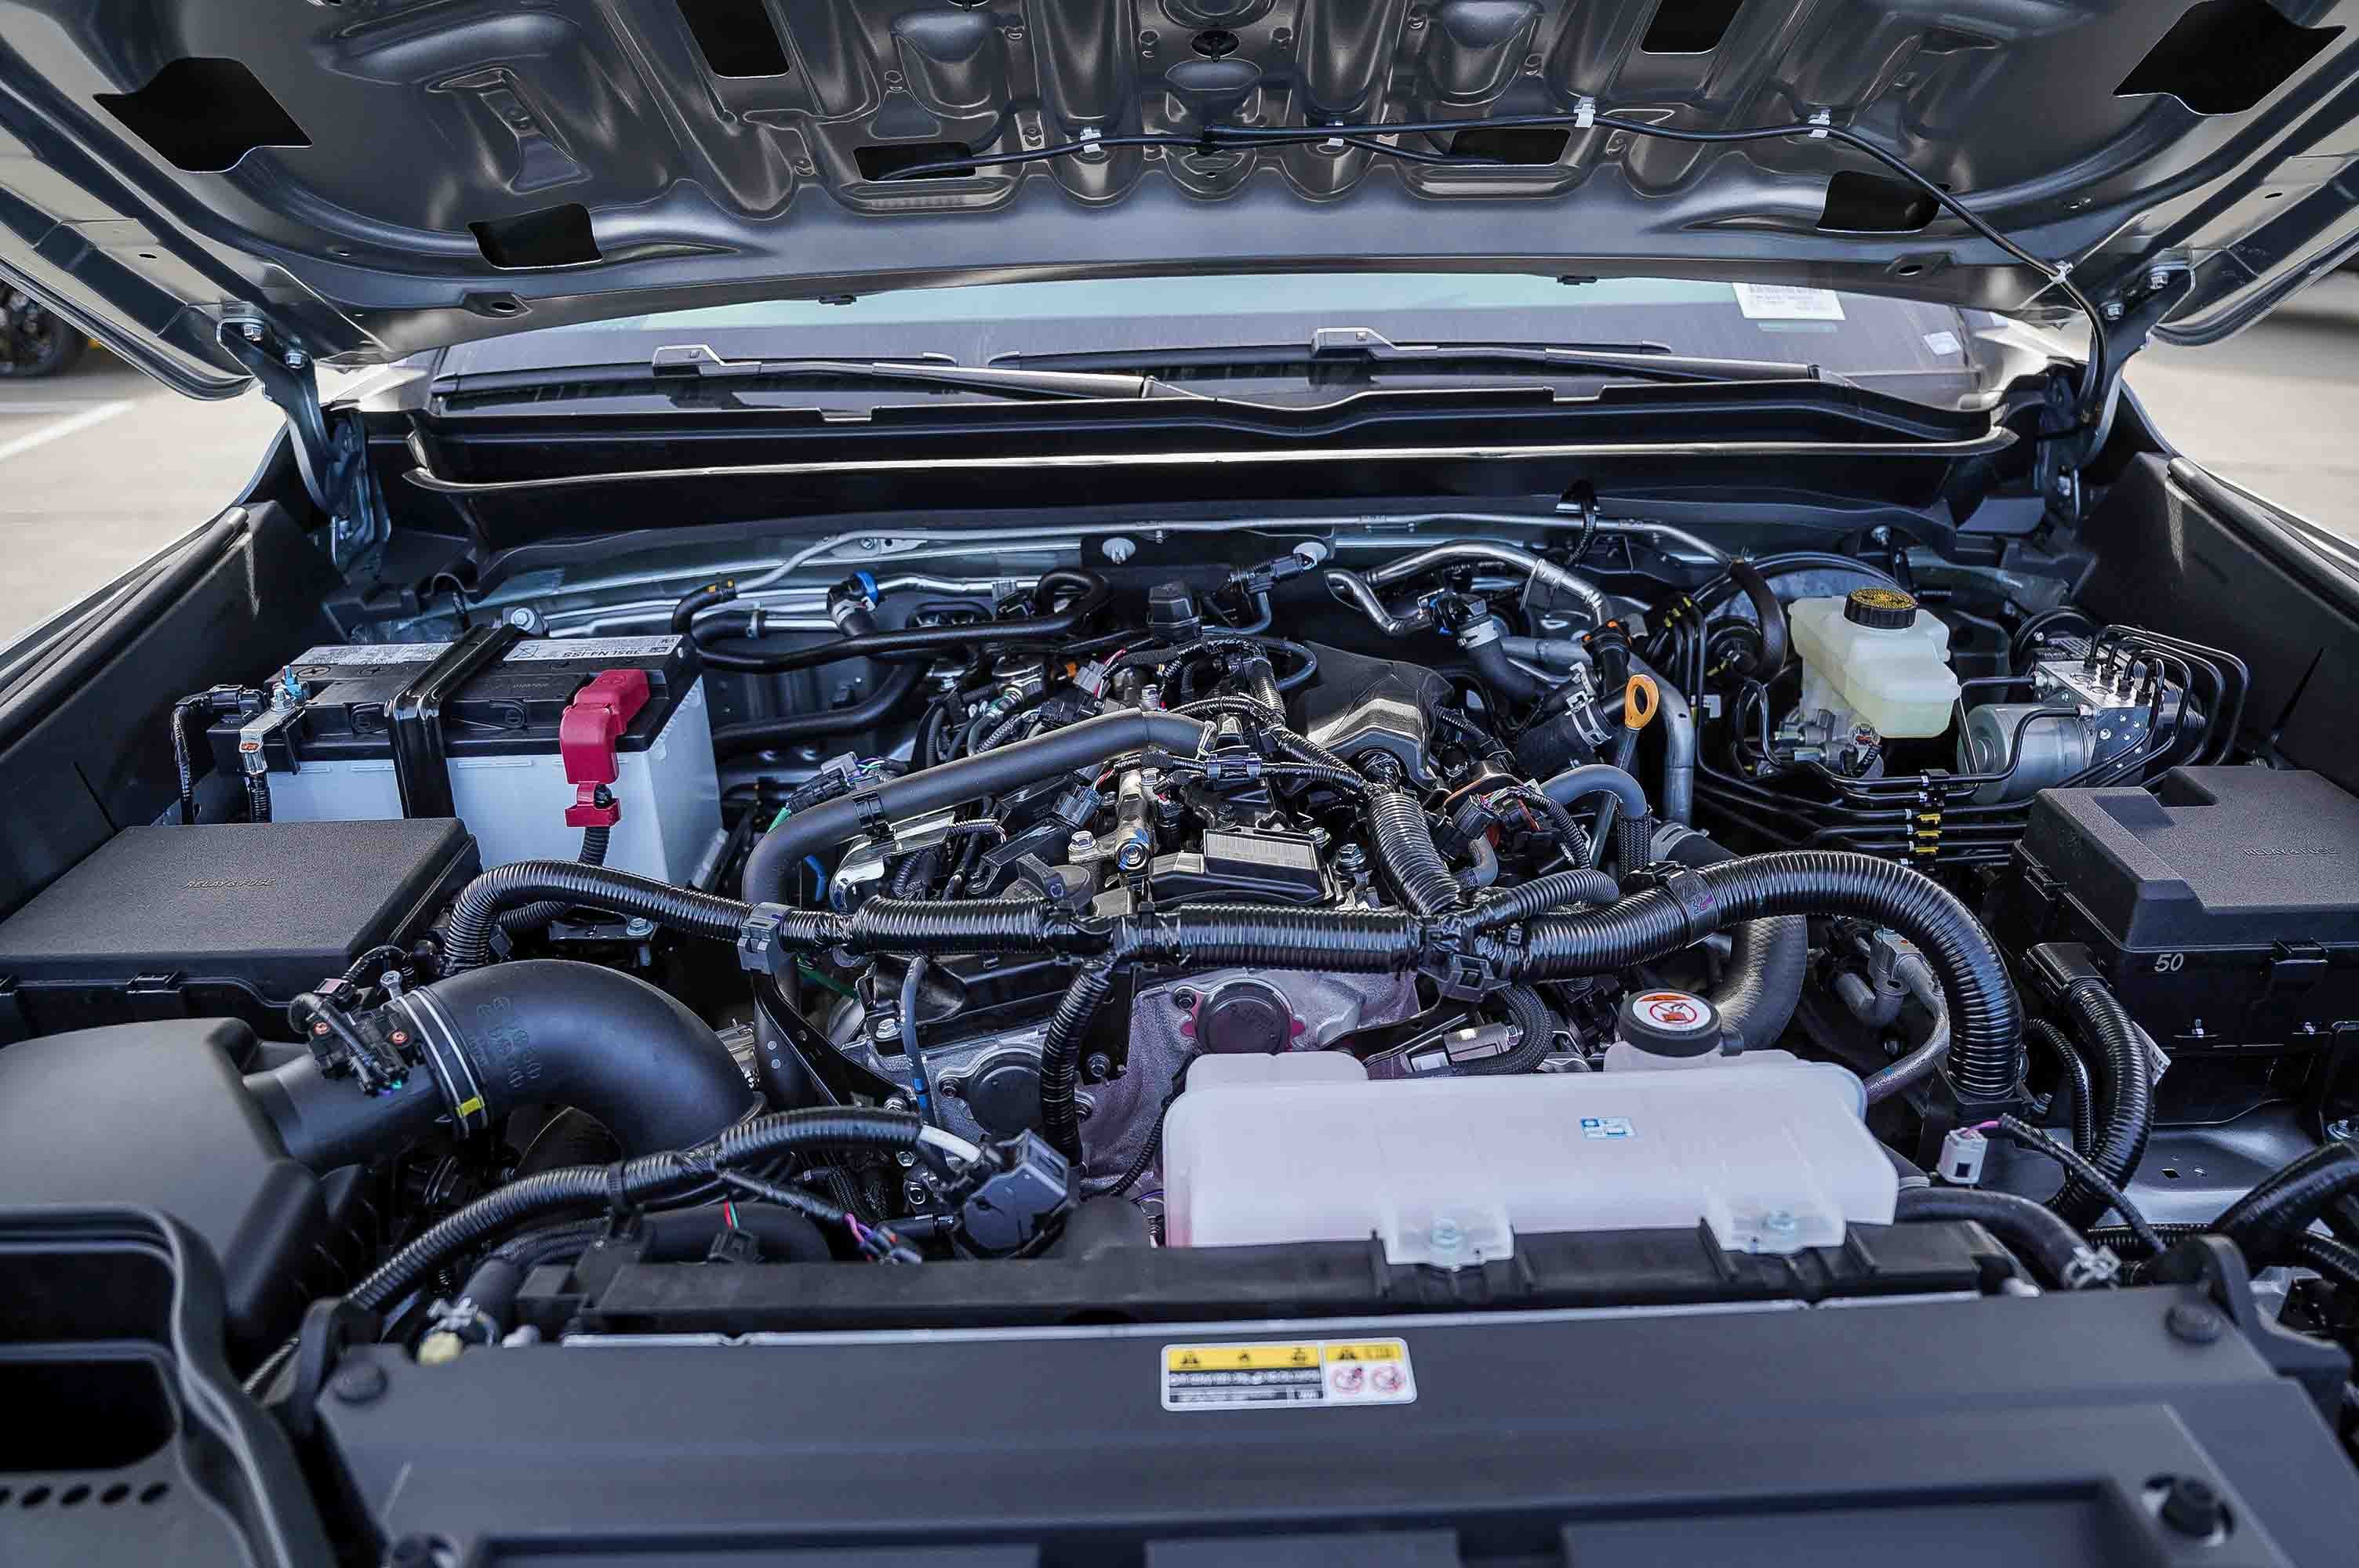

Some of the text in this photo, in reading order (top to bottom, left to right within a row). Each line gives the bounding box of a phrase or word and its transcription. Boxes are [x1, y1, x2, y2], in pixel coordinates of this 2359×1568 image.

[2240, 847, 2285, 856] RELAY
[2299, 846, 2339, 855] FUSE
[184, 880, 230, 888] RELAY
[238, 878, 276, 887] FUSE
[2154, 953, 2184, 972] 50
